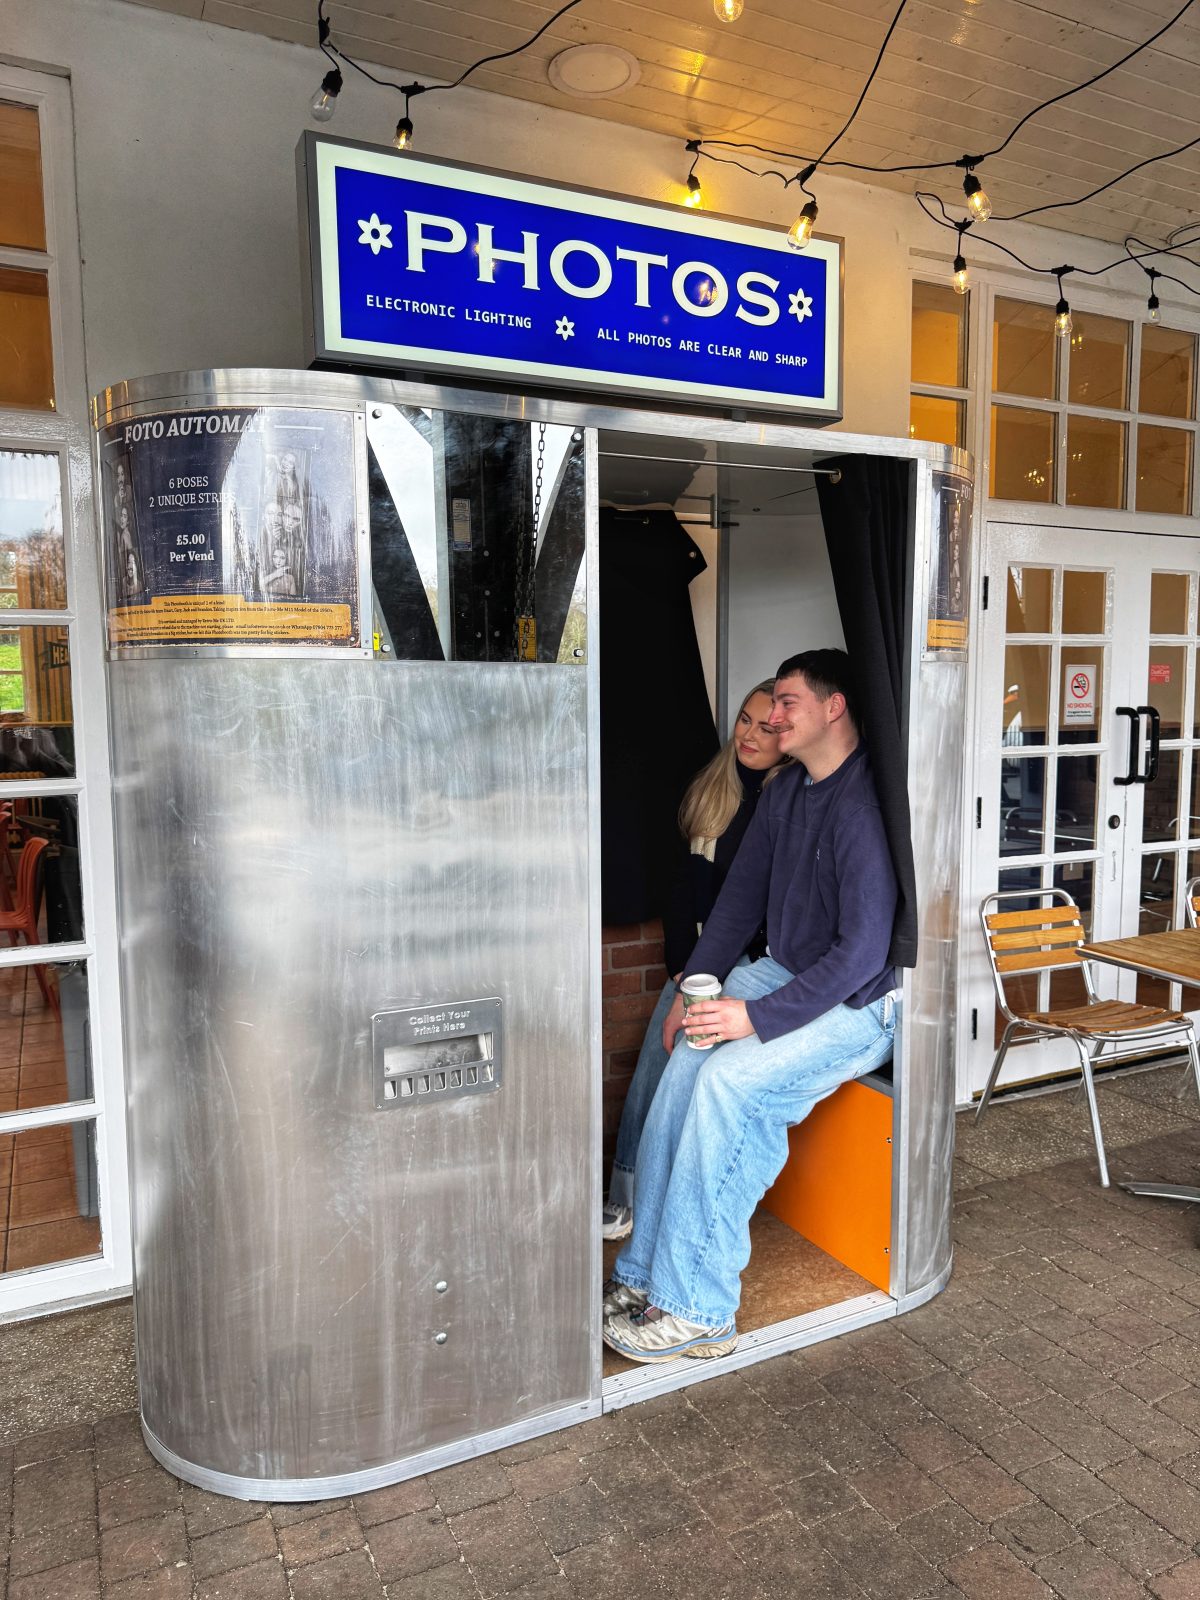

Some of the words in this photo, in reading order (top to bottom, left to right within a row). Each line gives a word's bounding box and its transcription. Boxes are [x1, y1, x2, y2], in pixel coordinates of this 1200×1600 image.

[404, 210, 780, 327] PHOTOS
[366, 294, 456, 318] ELECTRONIC
[465, 308, 532, 329] LIGHTING
[597, 328, 620, 341] ALL
[628, 332, 672, 348] PHOTOS
[679, 339, 700, 352] ARE
[707, 343, 742, 358] CLEAR
[748, 349, 769, 362] AND
[775, 353, 808, 367] SHARP
[125, 420, 165, 444] FOTO
[166, 414, 270, 437] AUTOMAT
[169, 479, 175, 489] 6
[177, 476, 209, 488] POSES
[149, 497, 155, 507] 2
[158, 492, 196, 506] UNIQUE
[176, 533, 205, 546] £5.00
[169, 552, 187, 562] Per
[188, 550, 214, 561] Vend
[409, 1012, 446, 1025] Collect
[447, 1010, 471, 1020] Your
[413, 1024, 440, 1036] Prints
[443, 1022, 466, 1032] Here
